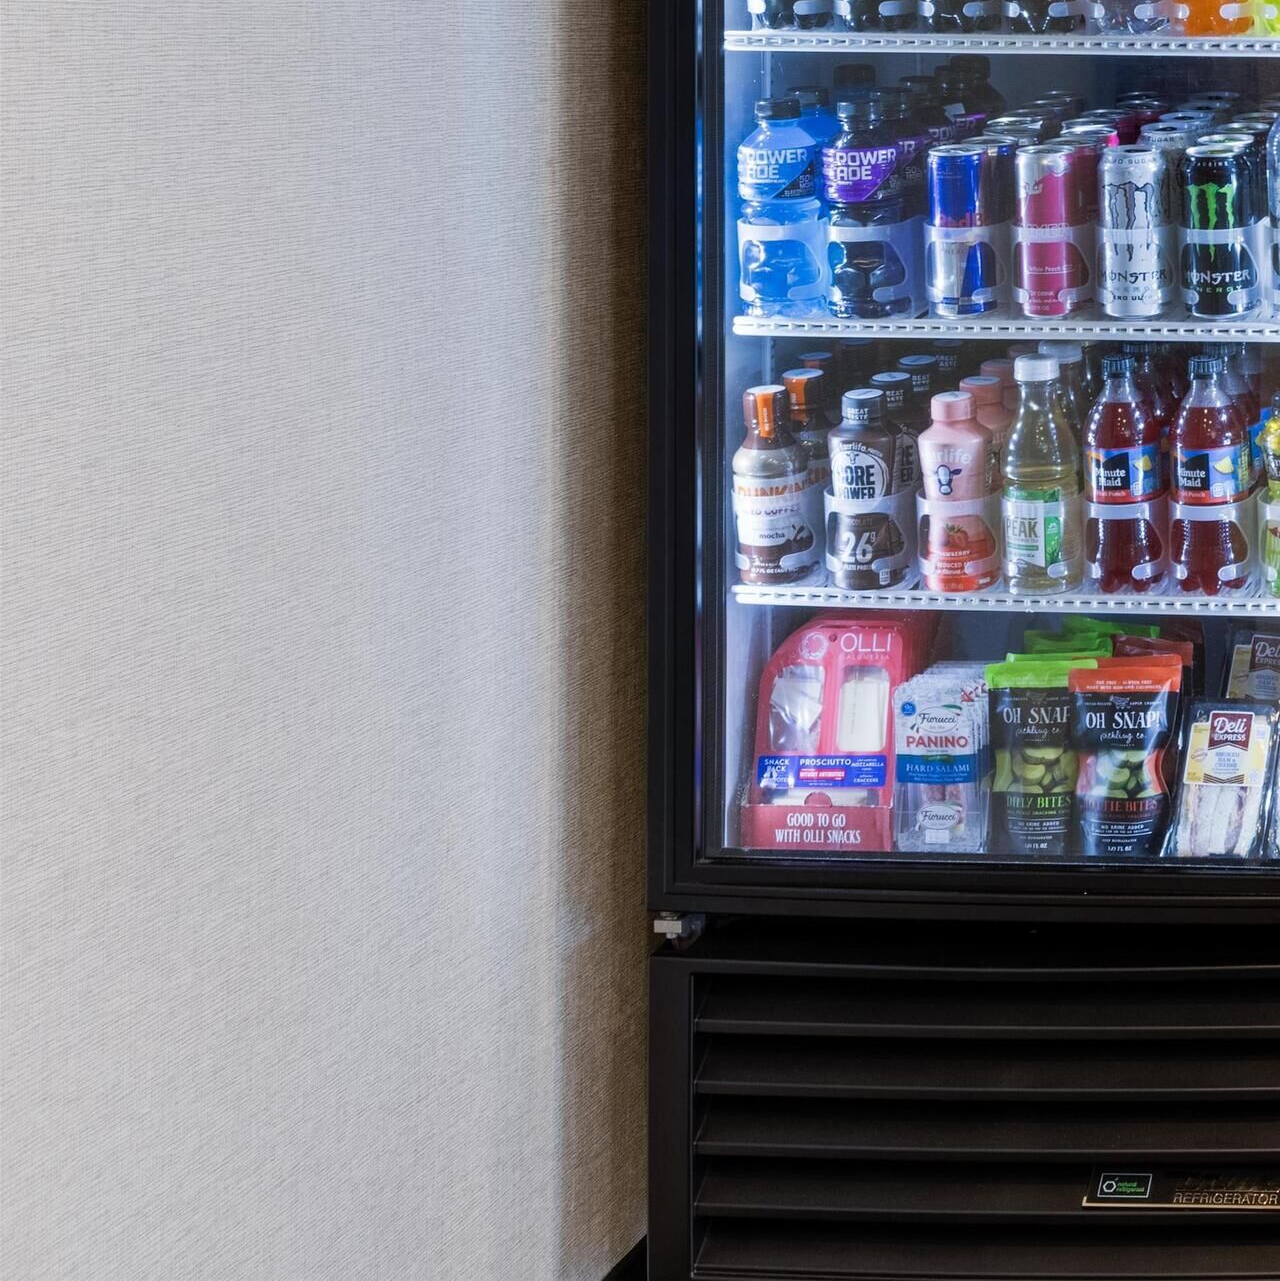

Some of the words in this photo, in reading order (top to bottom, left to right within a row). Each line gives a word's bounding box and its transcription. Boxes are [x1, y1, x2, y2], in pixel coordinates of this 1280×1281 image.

[832, 148, 896, 166] POWER
[1186, 269, 1251, 284] MONSTER
[846, 407, 869, 416] GREAT
[1095, 467, 1126, 478] Minute
[1098, 476, 1122, 488] Maid
[758, 530, 786, 541] mocha
[840, 632, 892, 653] OLLI
[1085, 711, 1105, 729] OH
[1112, 710, 1160, 728] SNAP!
[1214, 716, 1247, 734] Deli
[906, 735, 969, 749] PANINO
[1213, 732, 1247, 742] EXPRESS
[800, 758, 852, 766] PROSCIUTTO
[787, 813, 815, 827] GOOD
[816, 813, 830, 827] TO
[832, 813, 846, 827] GO
[775, 829, 802, 843] WITH
[804, 829, 825, 843] OLLI
[827, 829, 861, 844] SNACKS
[1173, 1192, 1279, 1205] REFRIGERATOR
